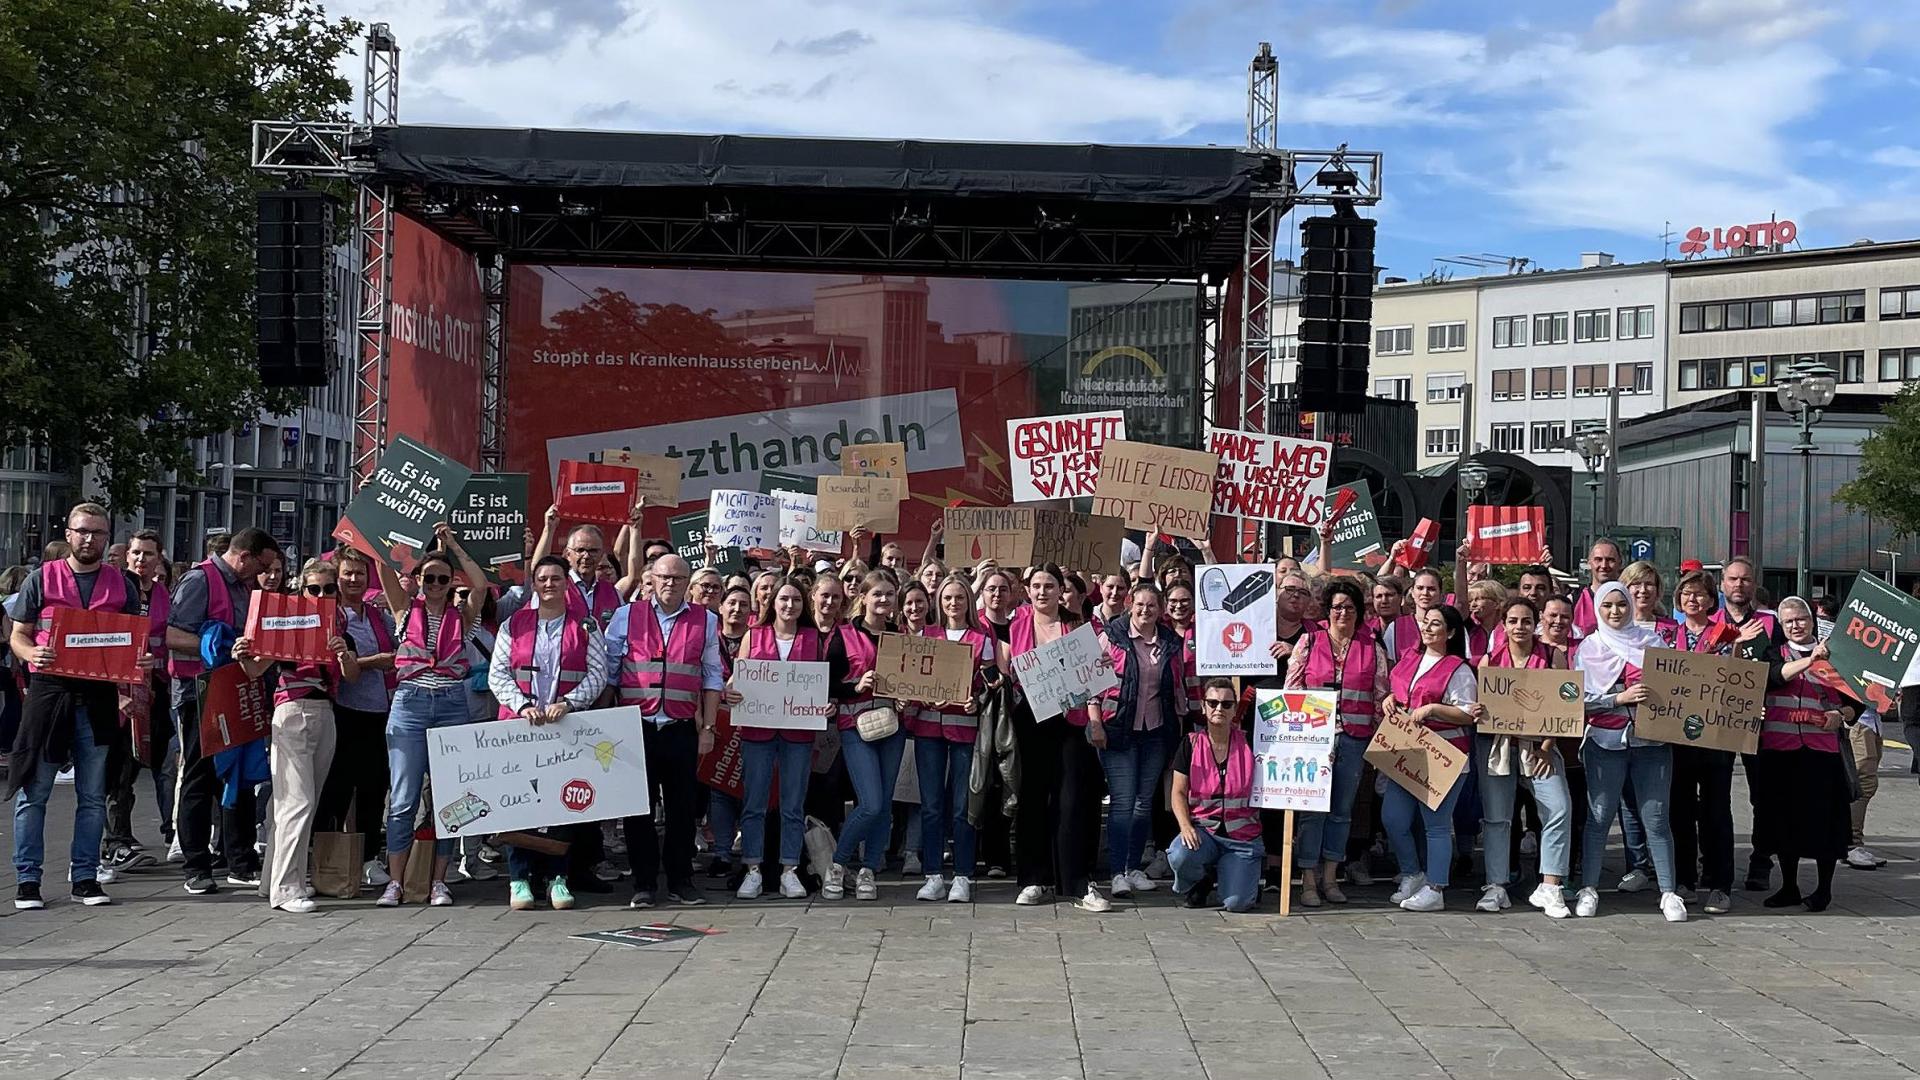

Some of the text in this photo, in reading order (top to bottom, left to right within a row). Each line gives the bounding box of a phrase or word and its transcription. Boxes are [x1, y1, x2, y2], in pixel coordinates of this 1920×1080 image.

[1713, 220, 1797, 251] LOTTO
[445, 313, 475, 367] ROT!
[532, 350, 809, 371] Stoppt das Krankenhaussterben!
[1080, 379, 1166, 392] Niedersächsische
[1060, 391, 1184, 408] Krankenhausgesellschaft
[1015, 417, 1122, 459] GESUNDHEIT
[1030, 456, 1055, 477] IST
[1273, 441, 1328, 478] WEG
[400, 461, 440, 491] Es ist
[1100, 456, 1214, 494] HILFE LEISTEN
[1217, 463, 1236, 480] ON
[376, 468, 446, 514] fünf nach
[469, 494, 508, 508] Es ist
[716, 491, 749, 507] NICHT
[377, 491, 427, 524] zwölf!
[1096, 496, 1208, 532] TOT SPAREN
[1212, 481, 1325, 526] RANKENHAUS
[451, 510, 524, 524] fünf nach
[945, 509, 1032, 530] PERSONALMANGEL
[1343, 509, 1374, 527] nach
[463, 526, 510, 540] zwölf!
[688, 531, 703, 542] Es
[1331, 524, 1367, 545] wölf!
[1639, 545, 1647, 556] P
[1849, 598, 1918, 644] Alarmstufe
[1229, 642, 1248, 650] STOP
[1846, 616, 1905, 662] ROT!
[737, 661, 779, 683] Profite
[884, 673, 962, 701] Gesundheit
[1671, 683, 1754, 714] die Pflege
[1284, 711, 1307, 721] SPD
[1648, 701, 1683, 721] geht
[1491, 715, 1583, 734] reicht NICHT
[439, 734, 460, 756] Im
[474, 730, 561, 748] Krankenhaus
[1260, 733, 1277, 742] Eure
[458, 764, 494, 784] bald
[501, 761, 523, 775] die
[500, 778, 542, 808] aus!
[565, 786, 592, 804] STOP
